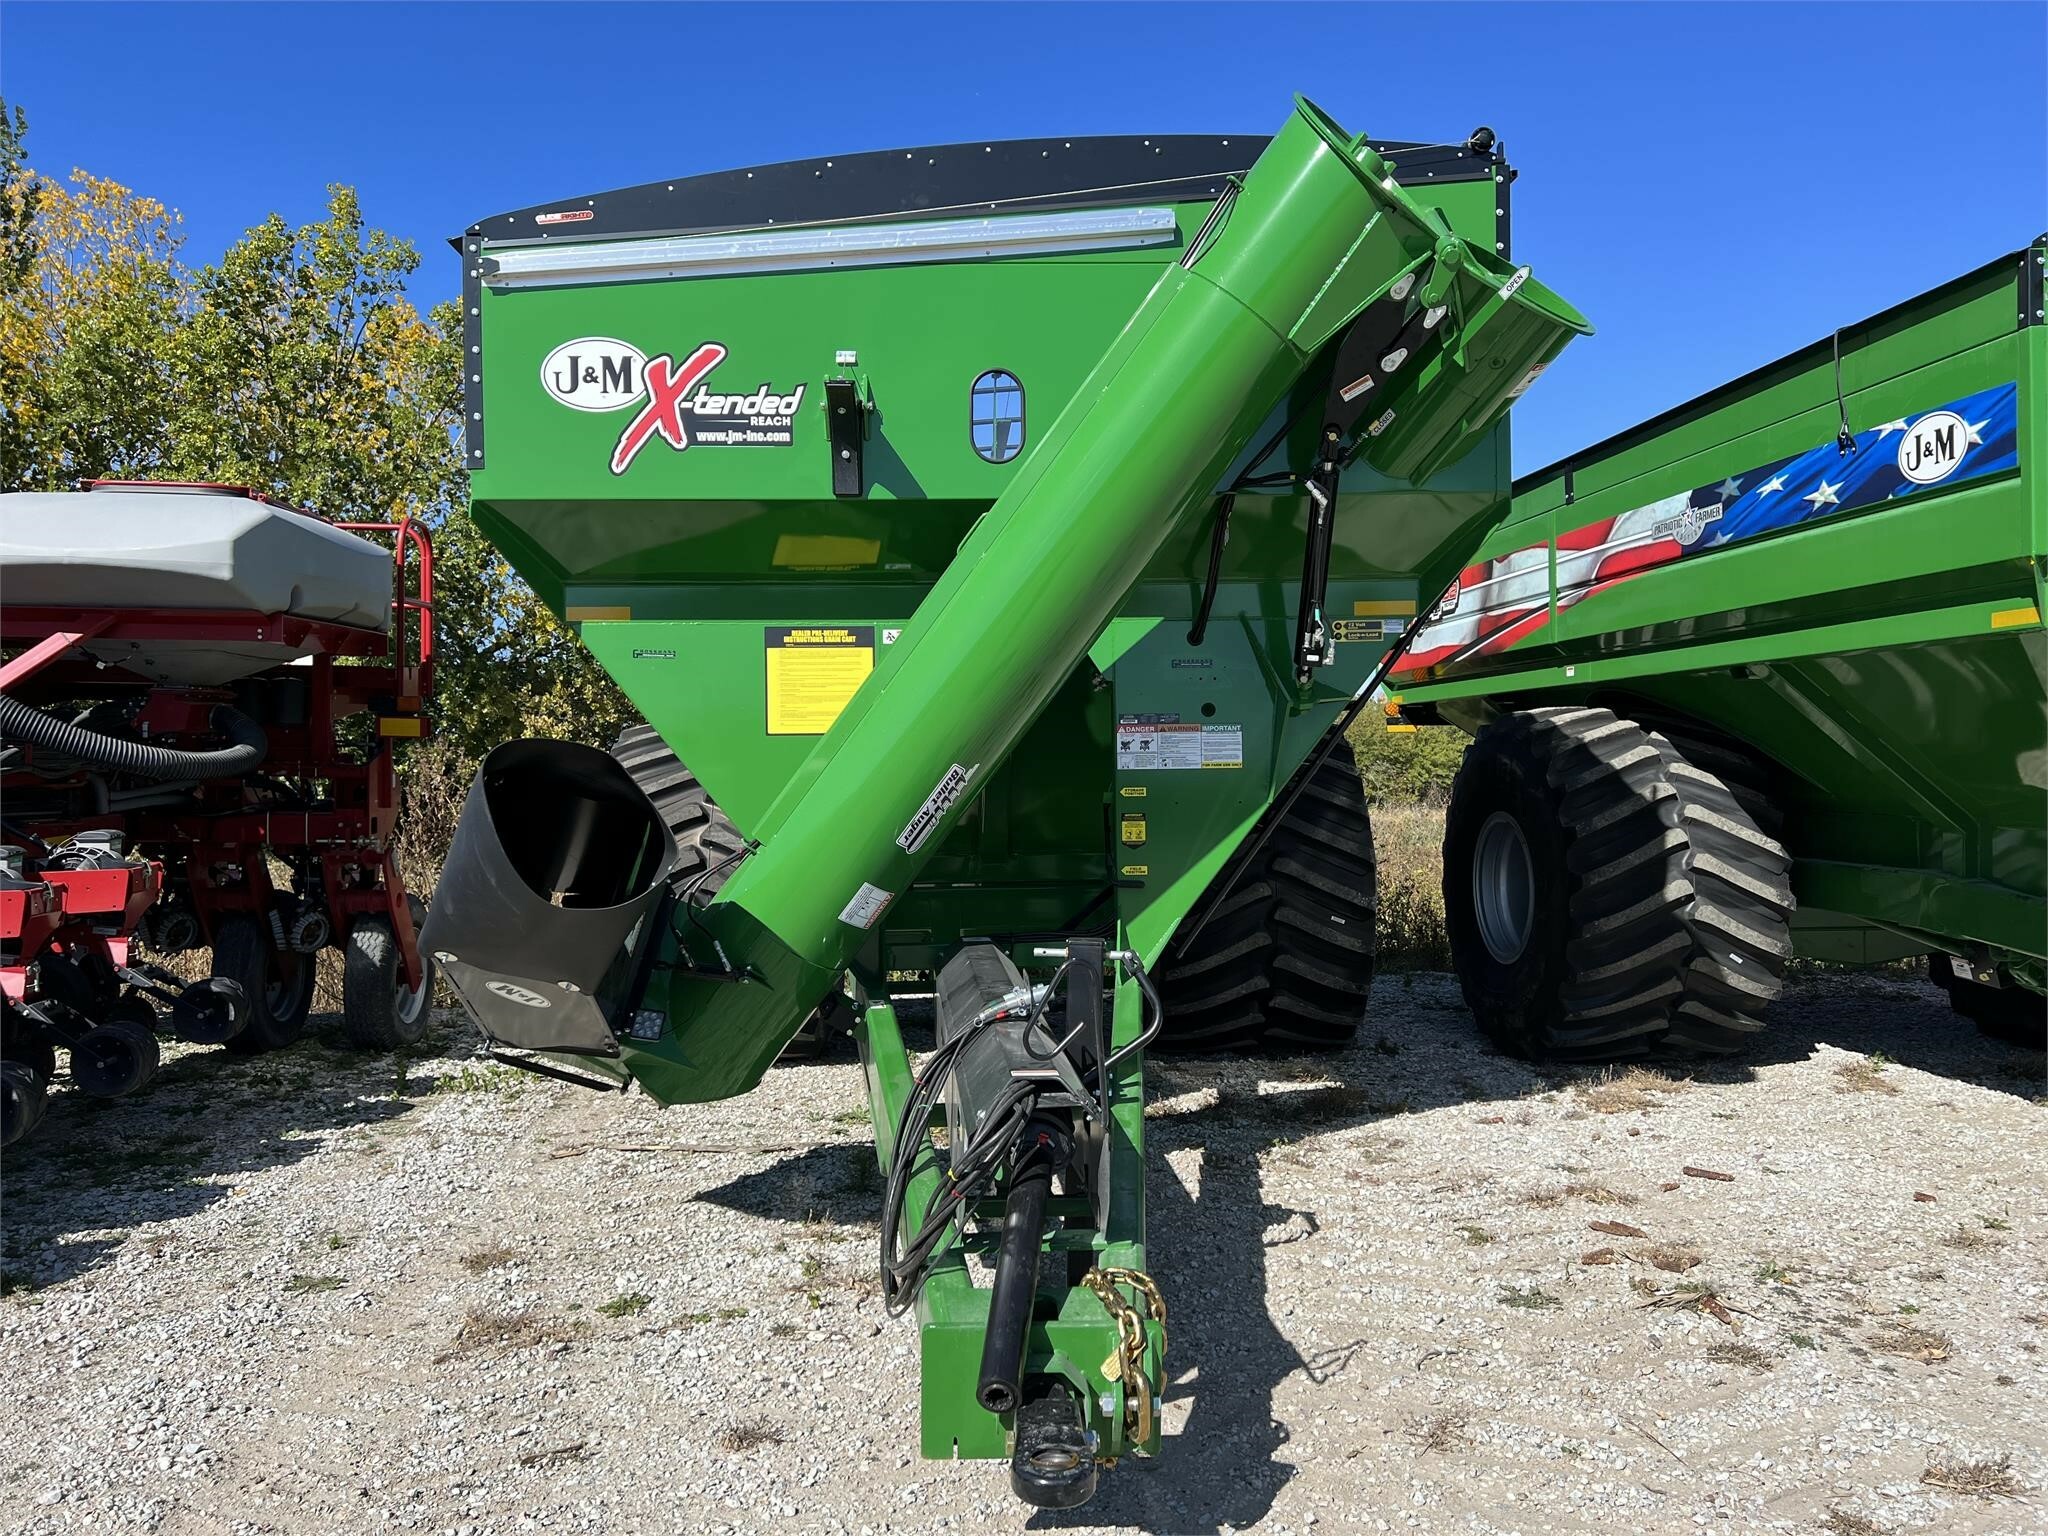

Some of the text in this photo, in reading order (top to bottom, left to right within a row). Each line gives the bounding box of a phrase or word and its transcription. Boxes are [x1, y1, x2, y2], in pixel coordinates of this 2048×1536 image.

[1506, 273, 1524, 292] OPEN
[553, 355, 635, 395] J&M
[750, 416, 791, 426] REACH
[1374, 412, 1393, 433] CLOSED
[696, 430, 791, 444] www.jm-inc.com
[1906, 423, 1956, 471] J&M
[1654, 506, 1721, 536] PATRIOTIC FARMER
[903, 769, 960, 844] Bullet Auger
